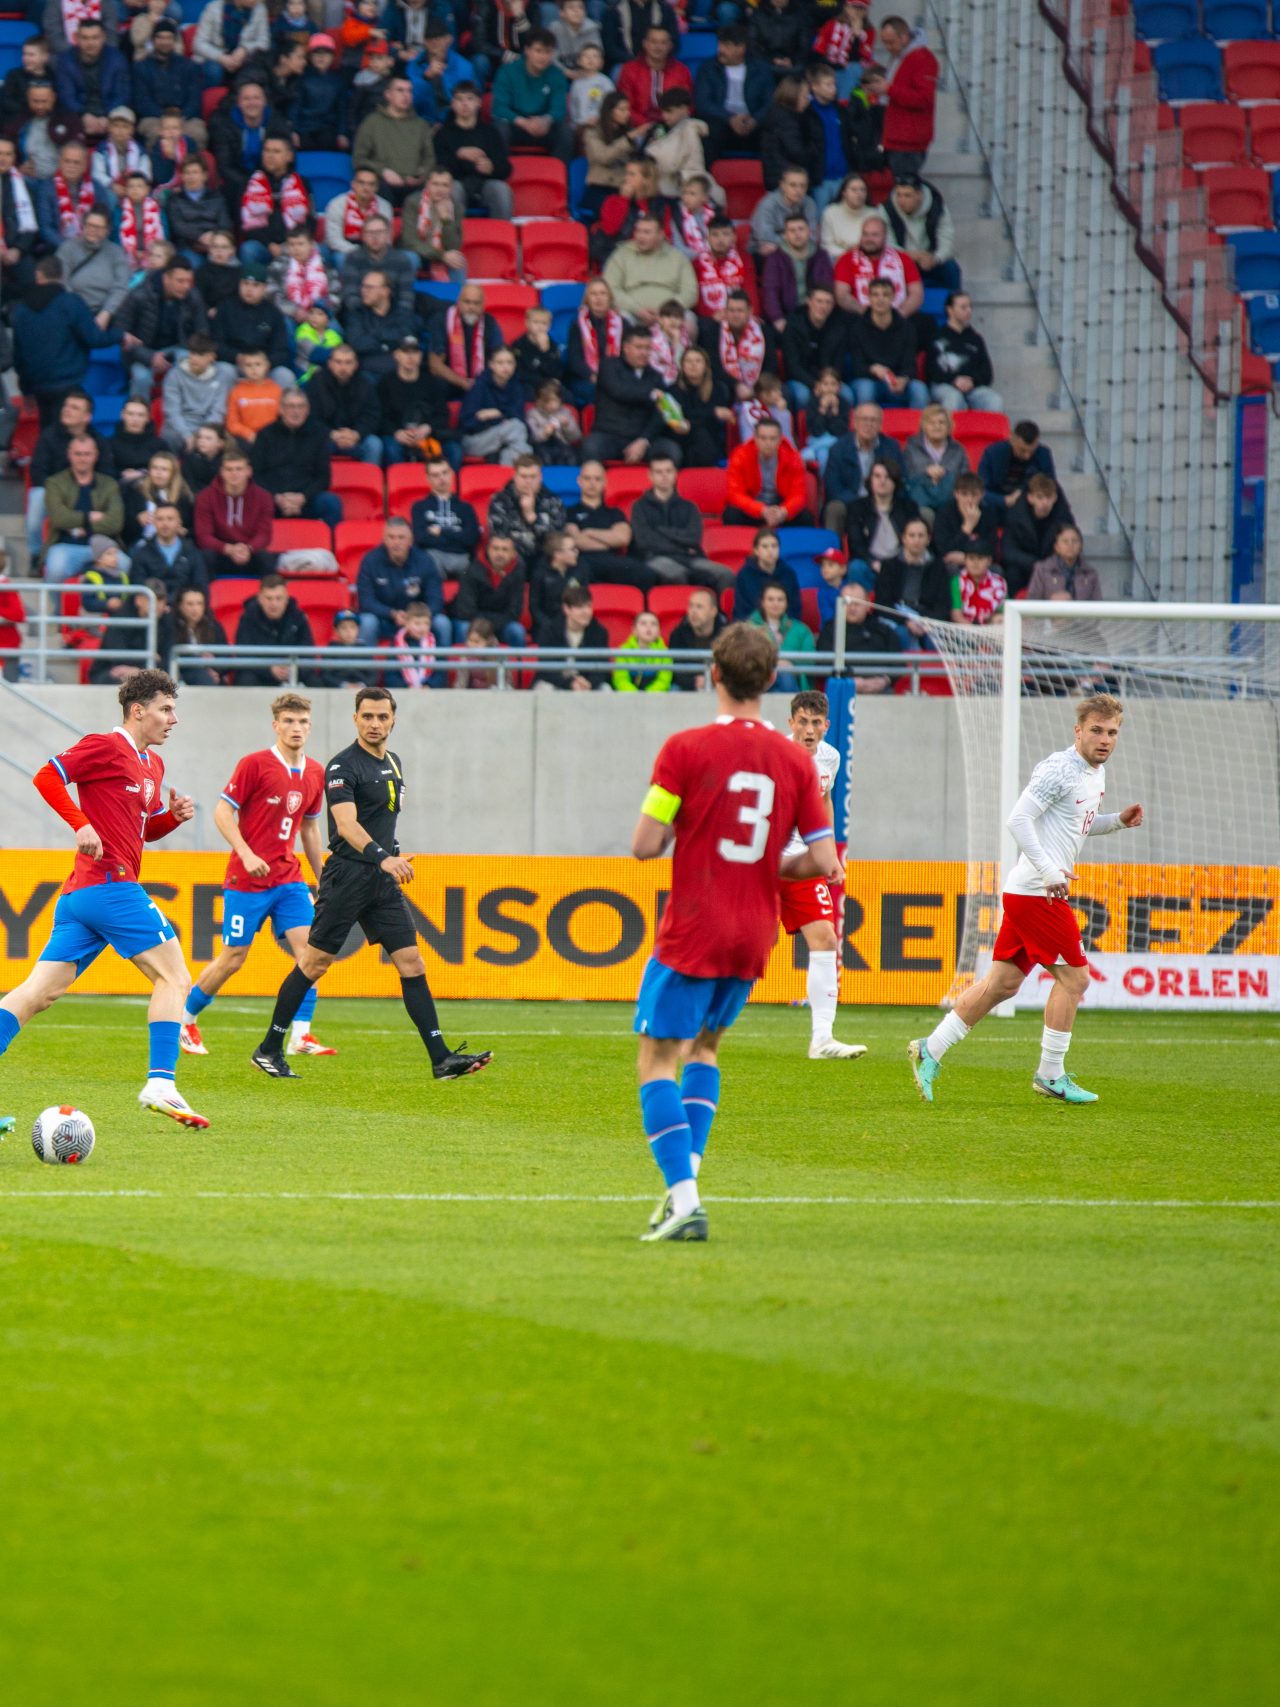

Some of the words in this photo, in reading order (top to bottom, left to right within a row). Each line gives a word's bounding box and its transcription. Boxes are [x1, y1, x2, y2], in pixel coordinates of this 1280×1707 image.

[279, 817, 294, 841] 9
[718, 771, 776, 864] 3
[148, 902, 168, 928] 7
[230, 914, 245, 938] 9
[1123, 966, 1269, 999] ORLEN
